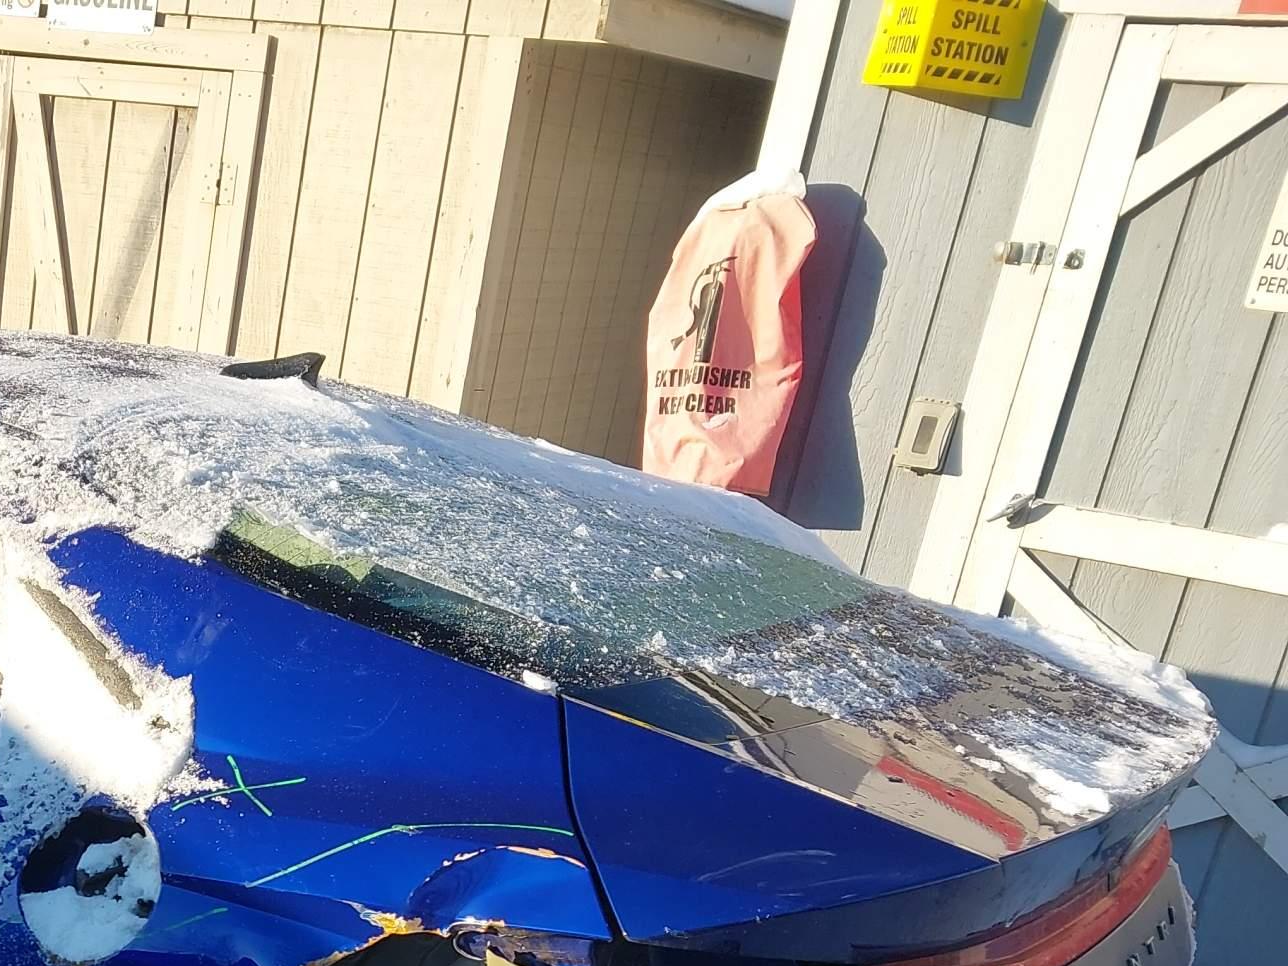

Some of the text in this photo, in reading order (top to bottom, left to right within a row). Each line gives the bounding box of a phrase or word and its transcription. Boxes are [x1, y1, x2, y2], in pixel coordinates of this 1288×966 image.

[897, 6, 919, 26] SPILL
[951, 9, 1001, 35] SPILL
[885, 35, 920, 54] STATION
[930, 36, 1010, 66] STATION
[685, 393, 736, 415] CLEAR
